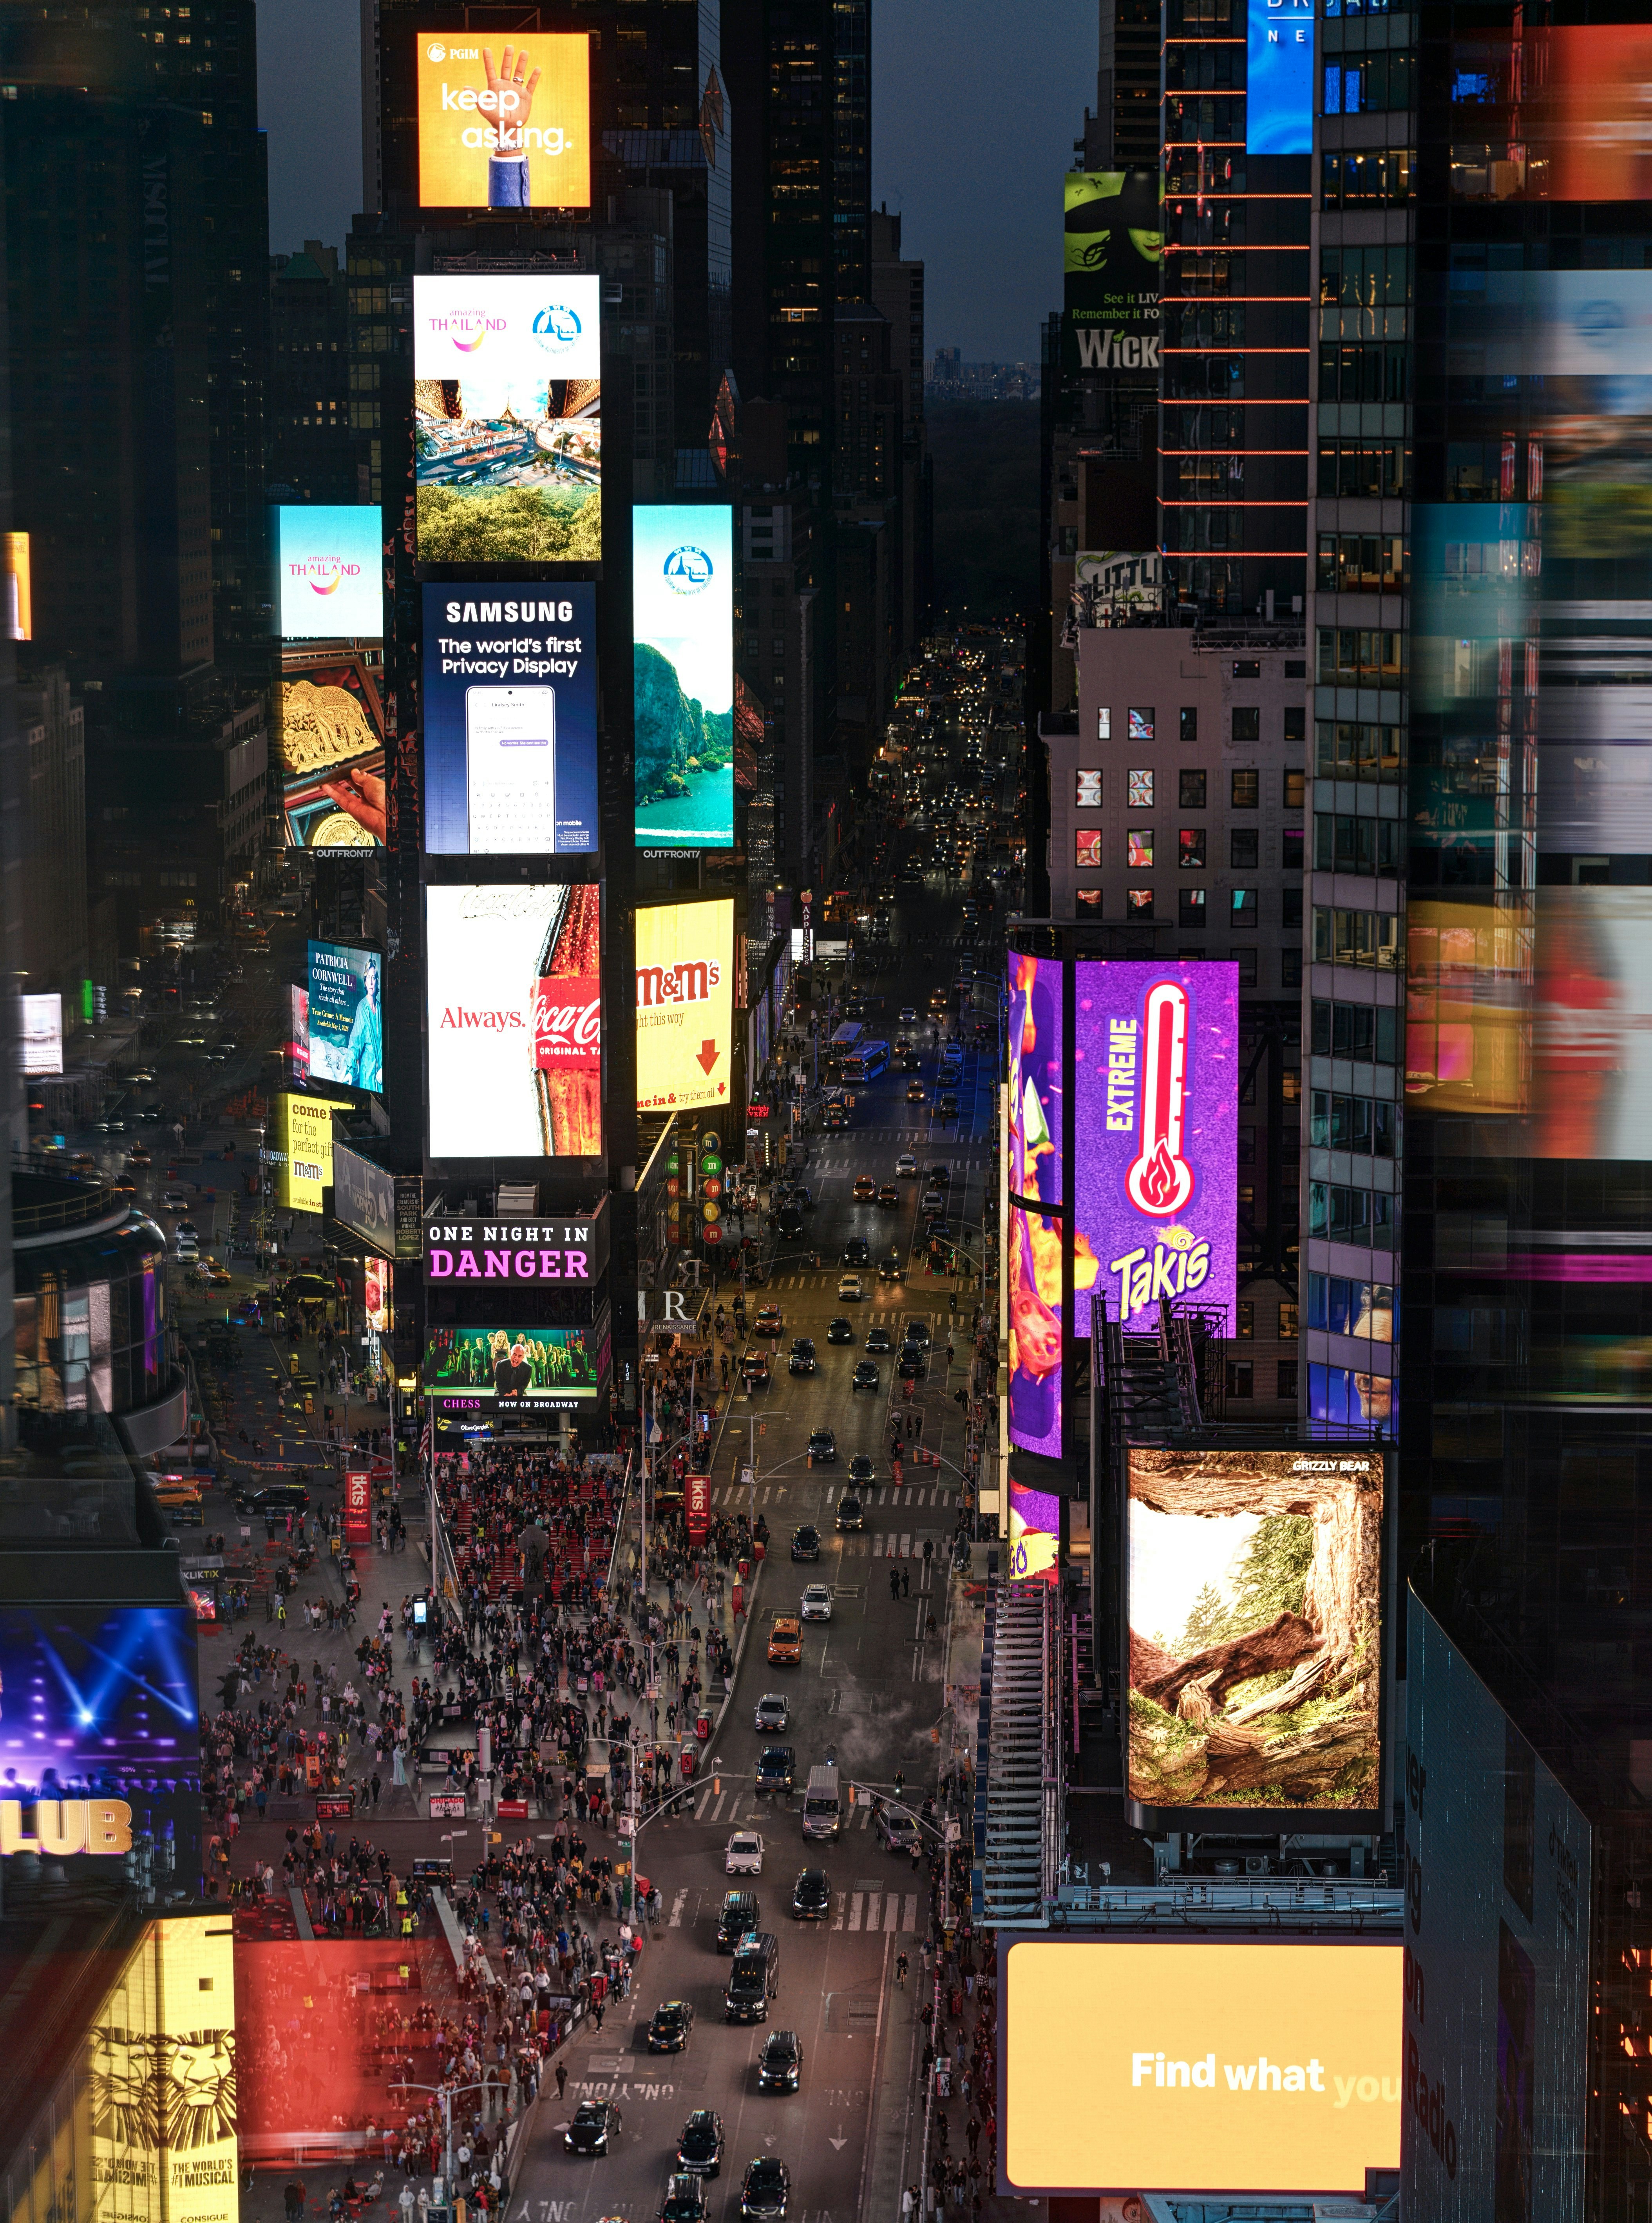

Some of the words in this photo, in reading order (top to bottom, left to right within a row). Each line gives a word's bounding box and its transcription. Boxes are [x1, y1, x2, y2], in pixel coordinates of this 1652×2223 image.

[450, 49, 479, 60] PGIM
[442, 83, 519, 117] keep
[461, 120, 572, 156] asking.
[1104, 293, 1123, 304] See
[1127, 293, 1135, 303] it
[450, 308, 486, 318] amazing
[1072, 308, 1129, 319] Remember
[1133, 309, 1140, 318] it
[429, 319, 507, 331] THAILAND
[308, 554, 341, 563] amazing
[288, 564, 360, 575] THAILAND
[675, 587, 696, 596] AUTHORITY
[700, 575, 712, 590] THAILAND
[447, 602, 572, 622] SAMSUNG
[438, 639, 472, 653] The
[476, 638, 541, 653] world's
[546, 637, 582, 653] first
[443, 658, 509, 678] Privacy
[514, 657, 578, 678] Display
[315, 952, 349, 970] PATRICIA
[312, 968, 352, 987] CORNWELL
[328, 987, 337, 995] story
[99, 986, 107, 1015] GIFTS
[318, 993, 329, 1002] rivals
[335, 997, 349, 1006] others...
[312, 1007, 321, 1016] True
[322, 1009, 335, 1019] Crime:
[339, 1014, 354, 1024] Memoir
[317, 1019, 331, 1028] Available
[440, 1006, 526, 1032] Always.
[650, 1013, 665, 1026] this
[668, 1013, 684, 1026] way
[1106, 1018, 1137, 1131] EXTREME
[653, 1095, 666, 1106] in
[668, 1093, 676, 1103] &
[679, 1093, 688, 1104] try
[690, 1090, 706, 1100] them
[292, 1104, 326, 1119] come
[293, 1119, 303, 1133] for
[304, 1121, 316, 1136] the
[293, 1138, 318, 1154] perfect
[320, 1142, 333, 1159] gift
[292, 1197, 308, 1205] available
[430, 1227, 472, 1241] ONE
[483, 1227, 554, 1241] NIGHT
[565, 1228, 588, 1241] IN
[431, 1250, 588, 1278] DANGER
[662, 1291, 694, 1320] R
[443, 1399, 481, 1409] CHESS
[1292, 1461, 1337, 1471] GRIZZLY
[1339, 1461, 1370, 1471] BEAR
[352, 1474, 367, 1506] tkts
[691, 1479, 707, 1510] tkts
[1132, 2051, 1216, 2087] Find
[1223, 2057, 1325, 2092] what
[172, 2162, 190, 2174] THE
[192, 2158, 233, 2172] WORLD'S
[185, 2170, 235, 2188] MUSICAL
[180, 2213, 228, 2223] CONSIGUE
